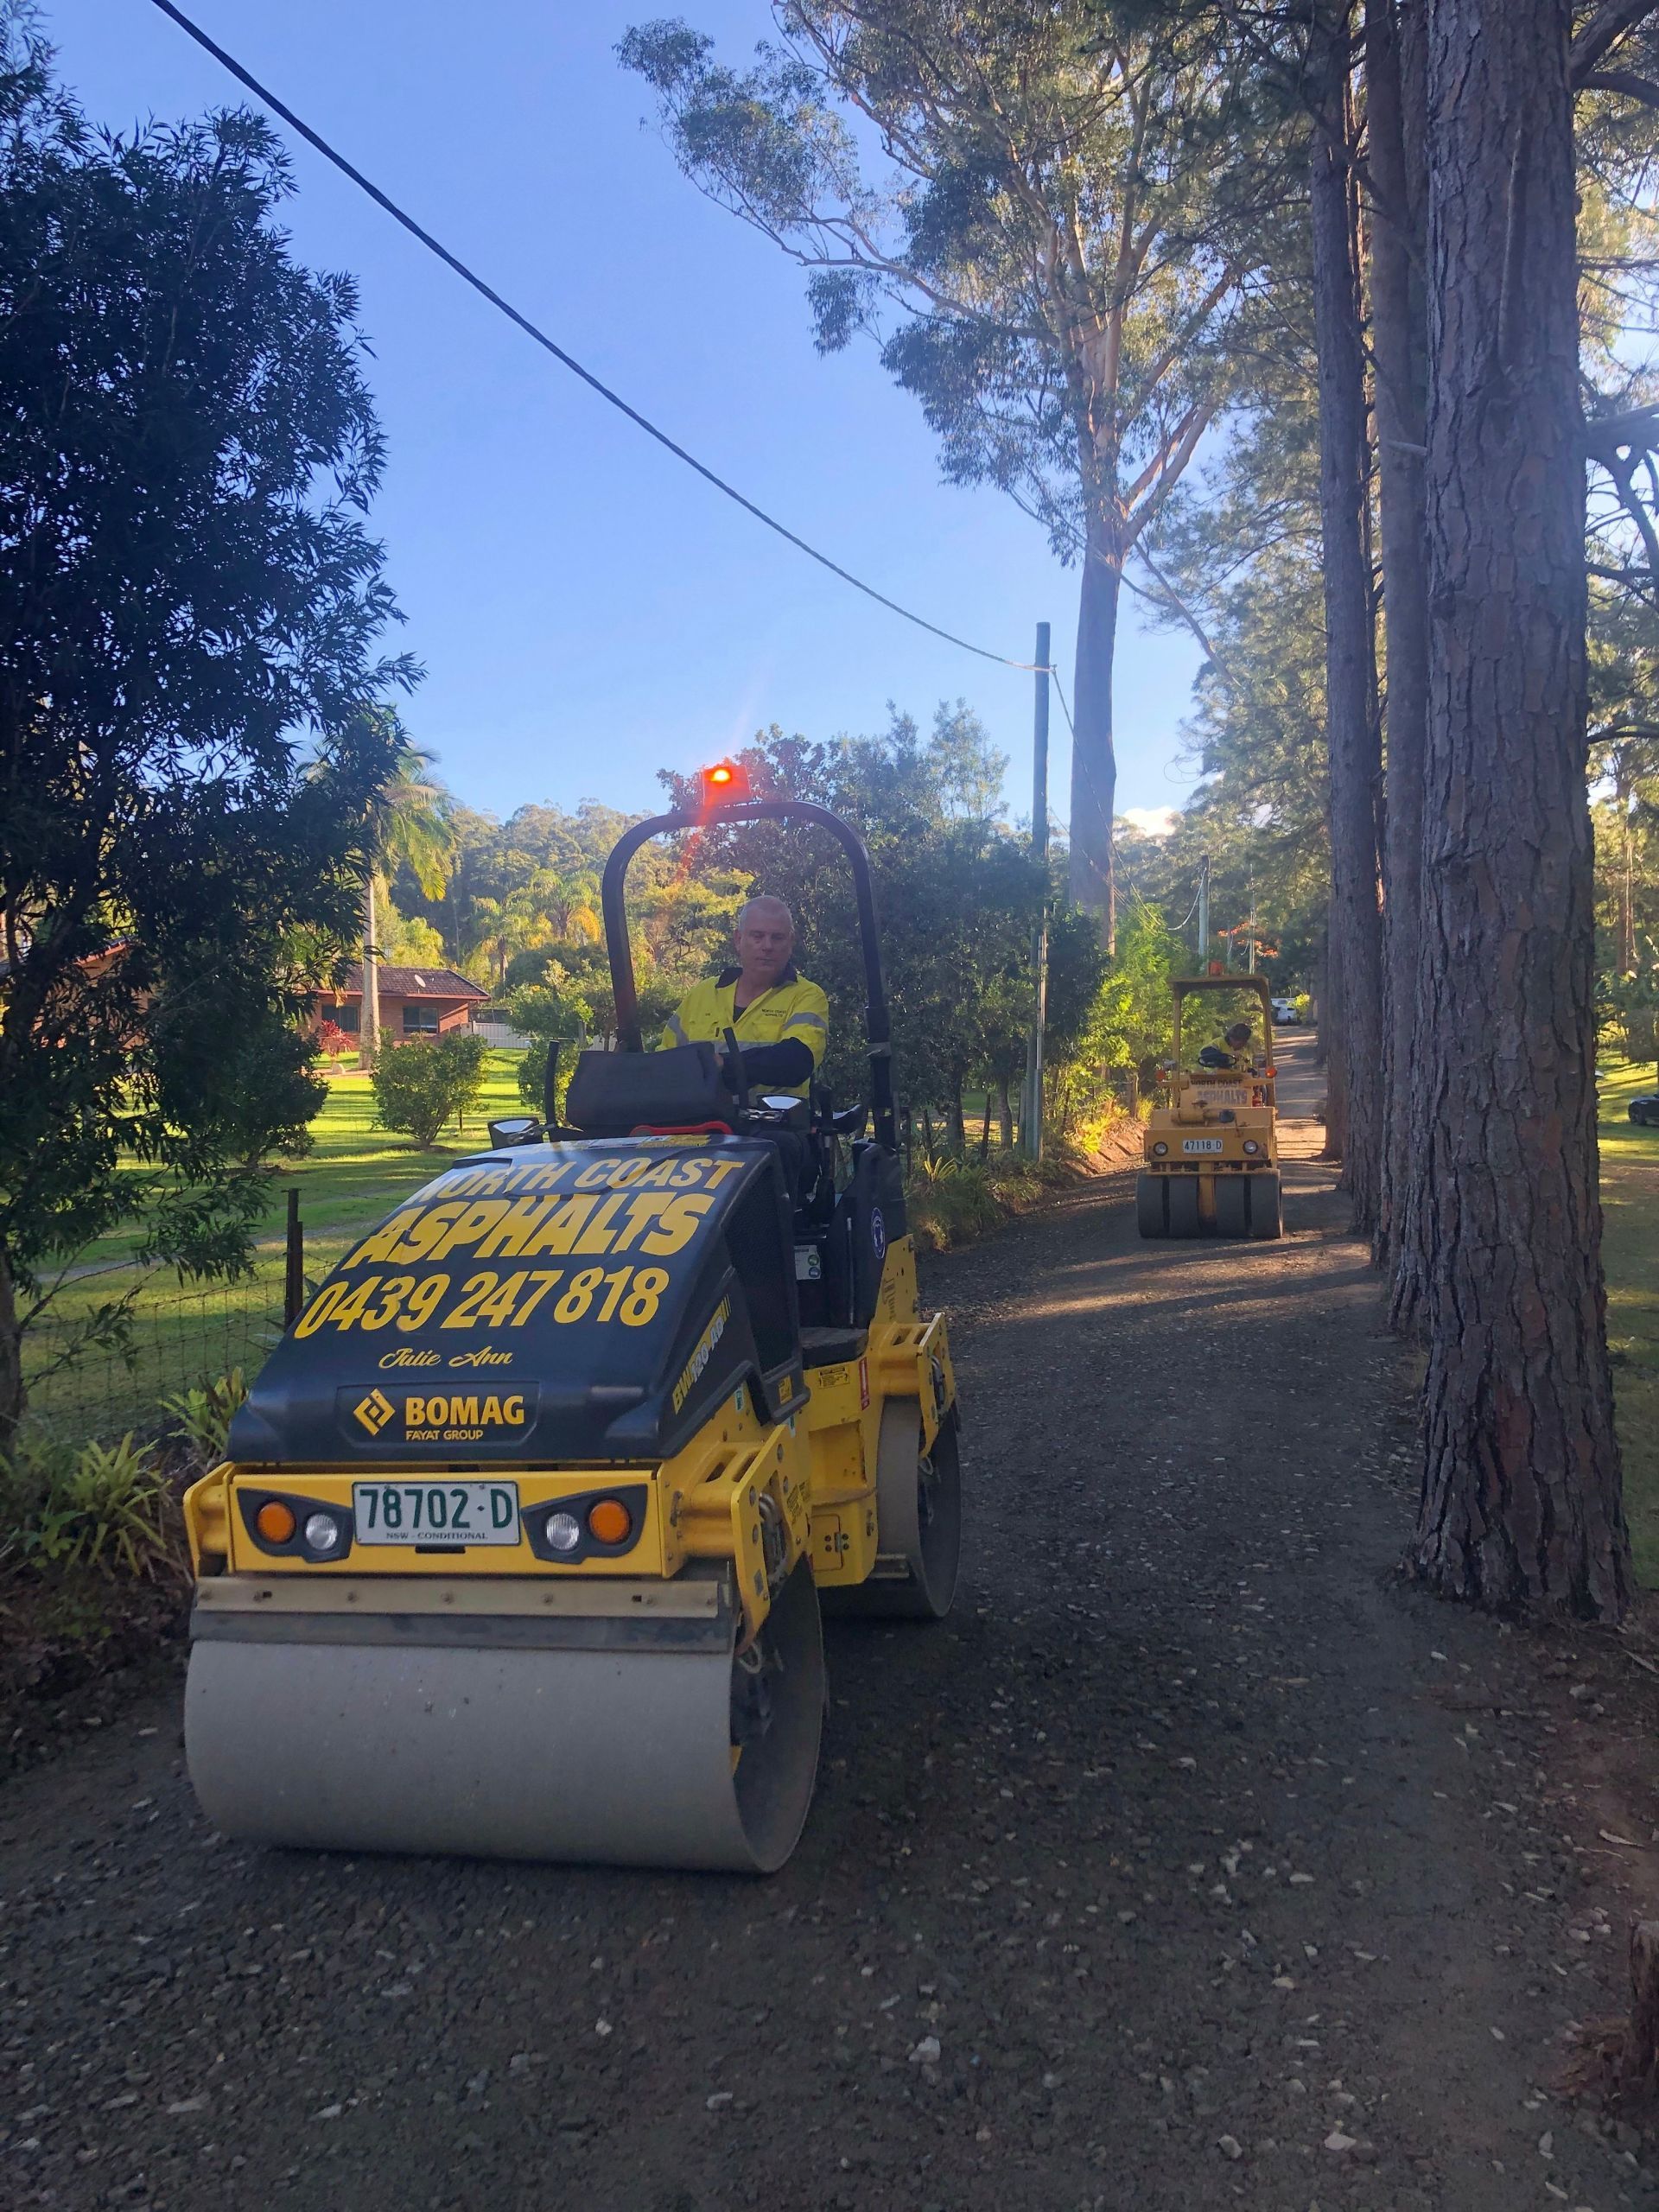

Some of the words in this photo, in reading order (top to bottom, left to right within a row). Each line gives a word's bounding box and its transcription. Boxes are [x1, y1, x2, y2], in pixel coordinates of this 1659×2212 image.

[404, 1161, 577, 1206] NORTH
[573, 1158, 746, 1190] COAST
[340, 1192, 715, 1271] ASPHALTS
[294, 1273, 451, 1339] 0439
[440, 1270, 564, 1329] 247
[553, 1265, 670, 1327] 818
[378, 1347, 442, 1369] Julie
[448, 1345, 513, 1367] Ann
[405, 1395, 524, 1426] BOMAG
[405, 1430, 440, 1440] FAYAT
[443, 1429, 484, 1440] GROUP
